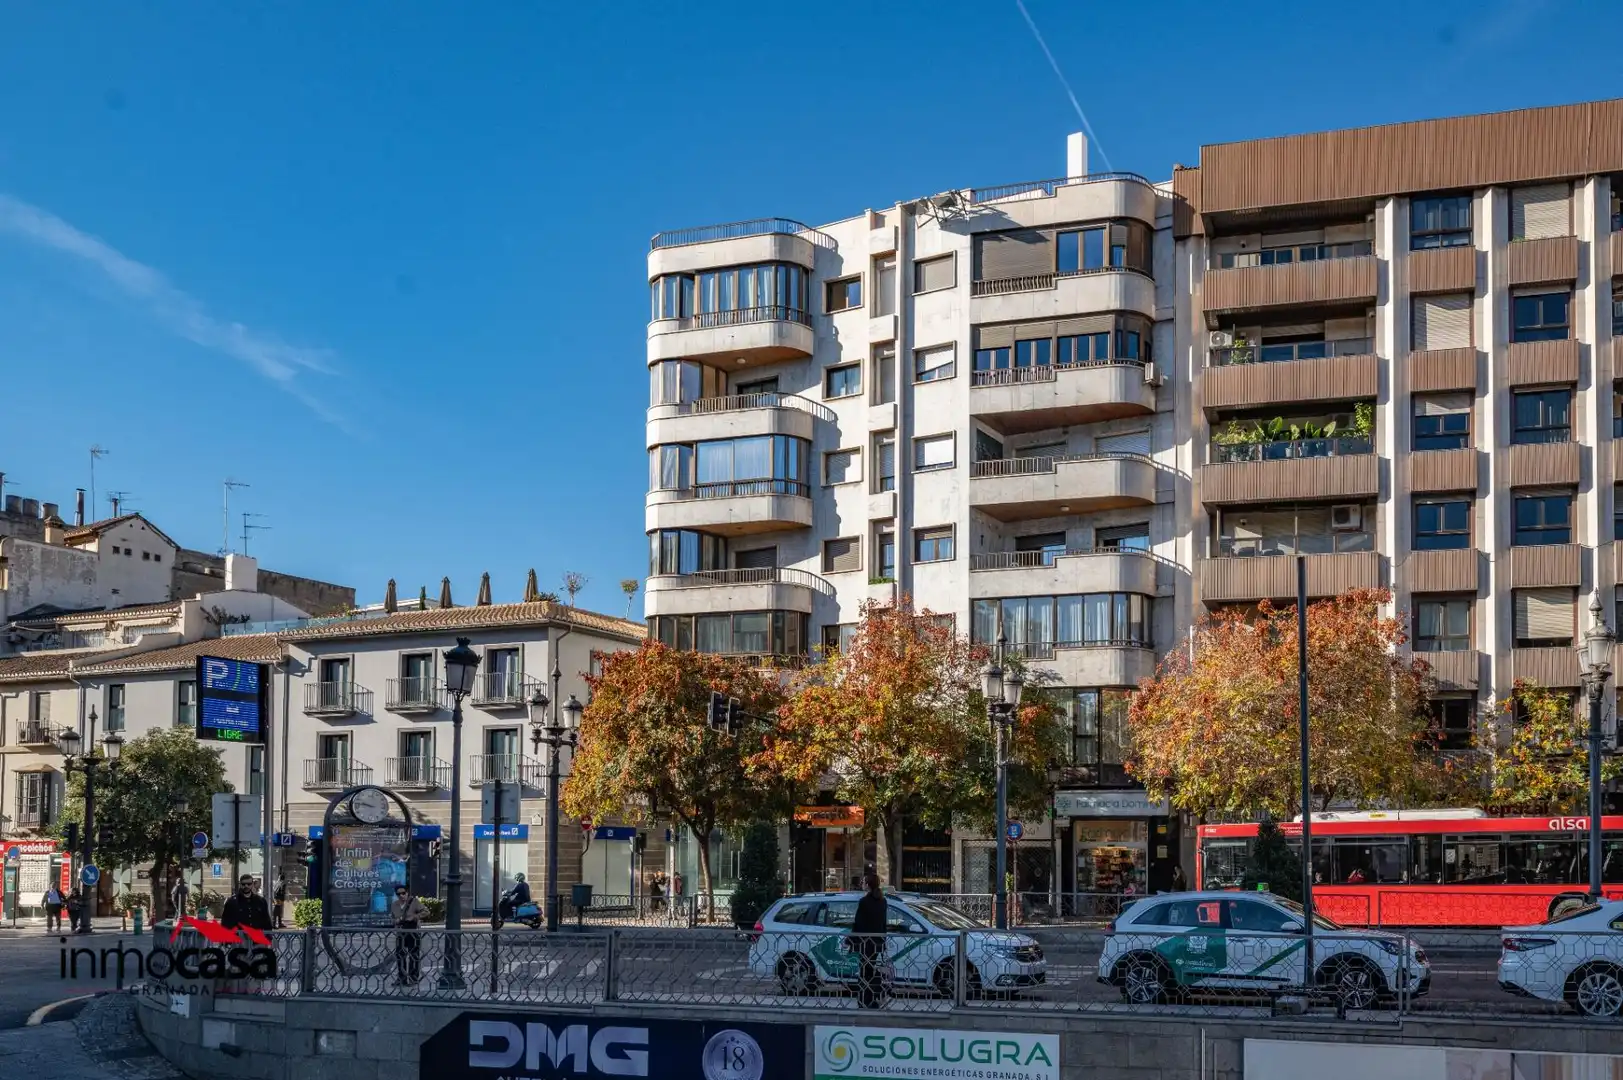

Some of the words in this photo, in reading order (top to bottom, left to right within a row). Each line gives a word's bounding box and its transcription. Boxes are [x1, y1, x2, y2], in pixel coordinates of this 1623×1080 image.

[217, 729, 243, 739] LIBRE
[1548, 817, 1587, 831] alsa
[335, 847, 373, 858] L'Infini
[335, 859, 354, 868] des
[469, 1019, 649, 1077] DMG
[863, 1035, 1053, 1067] SOLUGRA
[722, 1046, 745, 1072] 18
[862, 1065, 919, 1076] SOLUCIONES
[920, 1067, 985, 1079] ENERGÉTICAS
